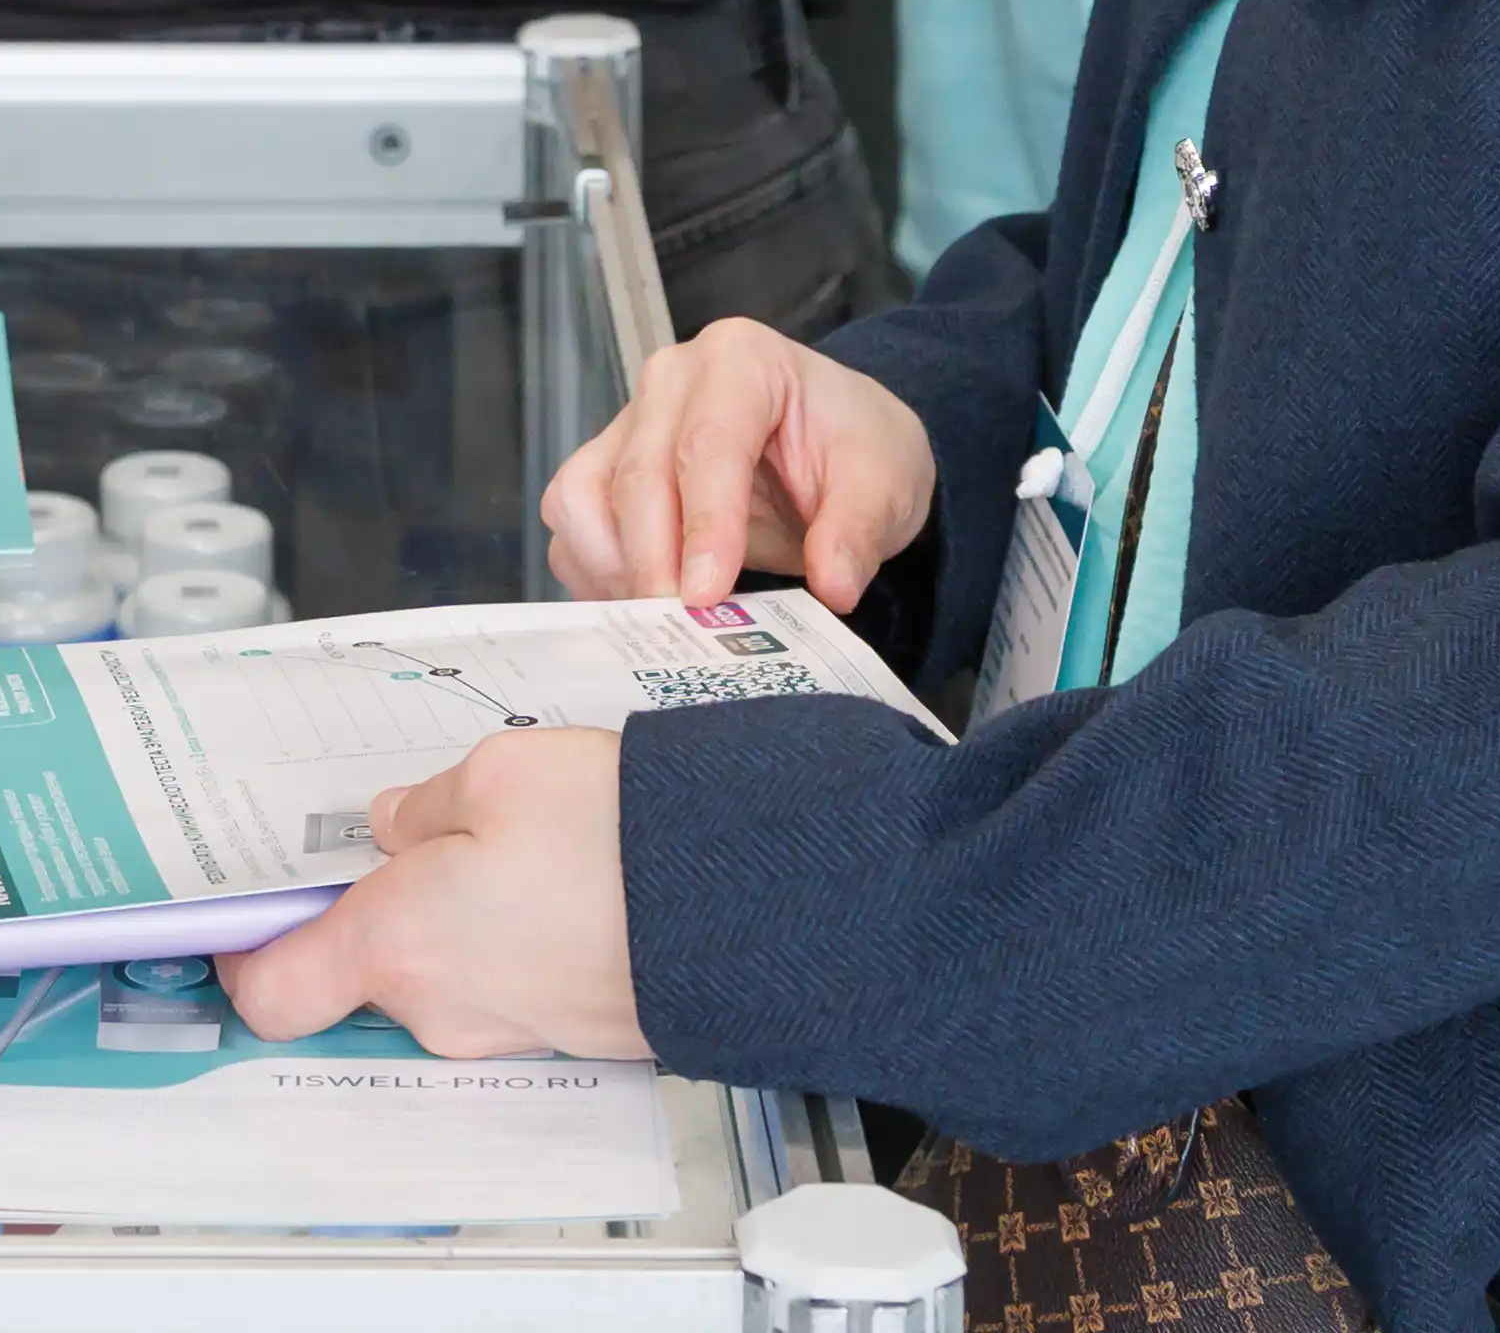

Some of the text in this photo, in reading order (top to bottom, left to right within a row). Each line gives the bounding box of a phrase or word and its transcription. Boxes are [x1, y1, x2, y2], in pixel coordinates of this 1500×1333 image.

[122, 704, 160, 749] ЭМАЛЕВОЙ
[148, 750, 174, 776] ТЕСТА
[161, 776, 204, 842] КЛИНИЧЕСКОГО
[271, 1074, 599, 1089] TISWELL-PRO.RU
